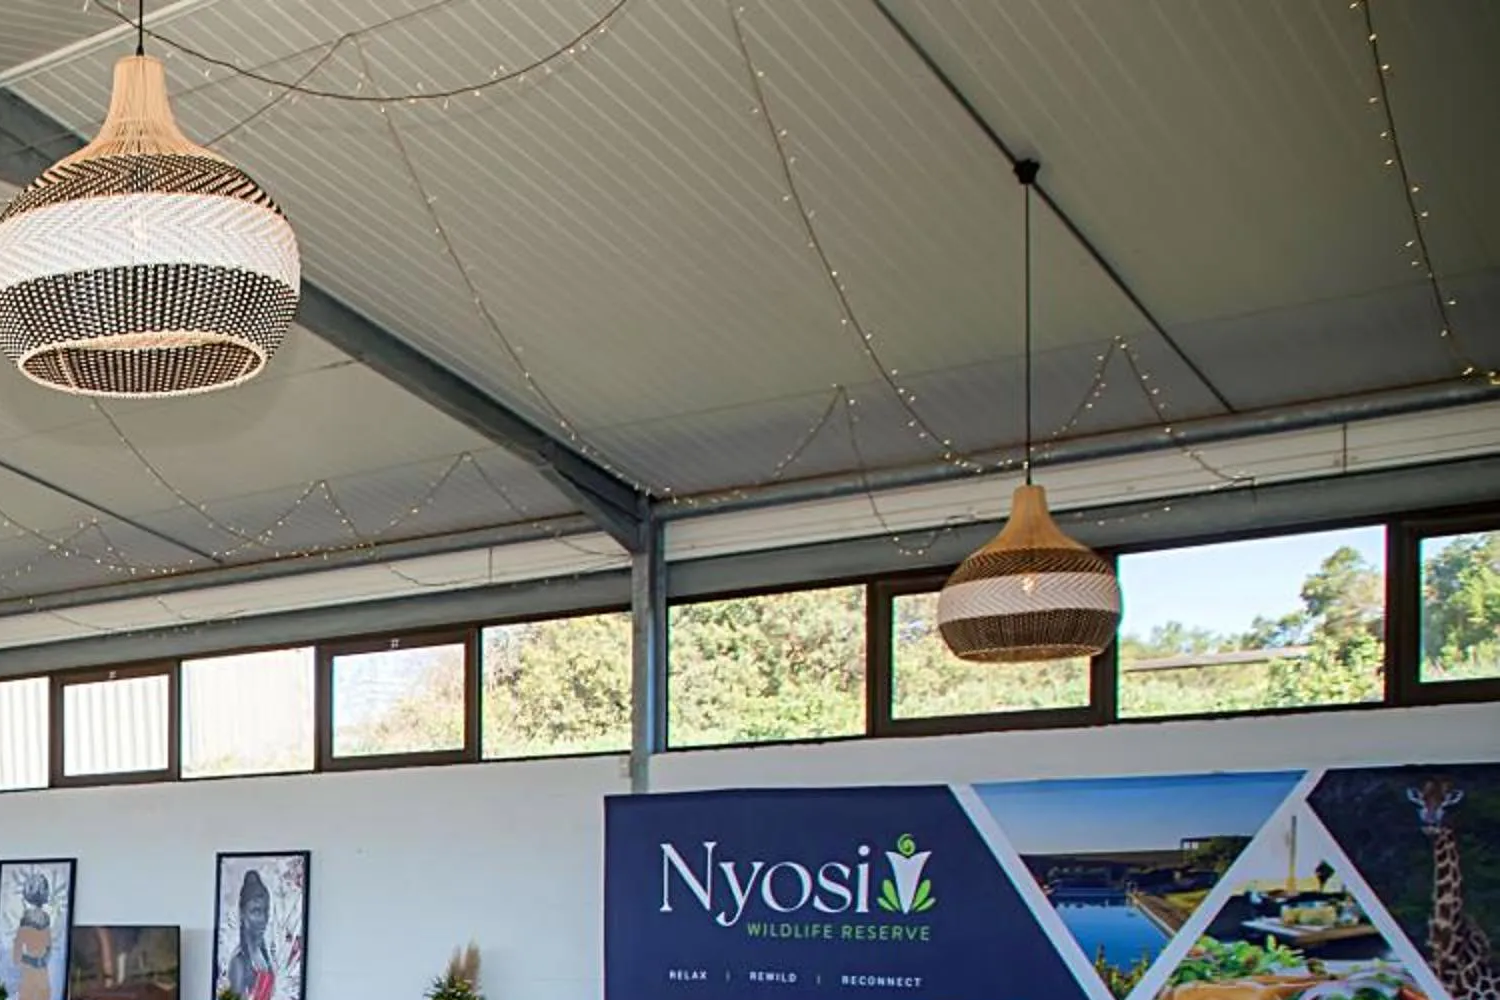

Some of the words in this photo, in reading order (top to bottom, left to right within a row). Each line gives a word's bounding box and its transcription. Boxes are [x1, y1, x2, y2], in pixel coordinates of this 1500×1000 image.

[659, 841, 871, 927] Nyosi
[747, 922, 833, 939] WILDLIFE
[841, 924, 931, 942] RESERVE
[669, 969, 708, 982] RELAX
[749, 971, 798, 984] REWILD
[841, 974, 922, 988] RECONNECT
